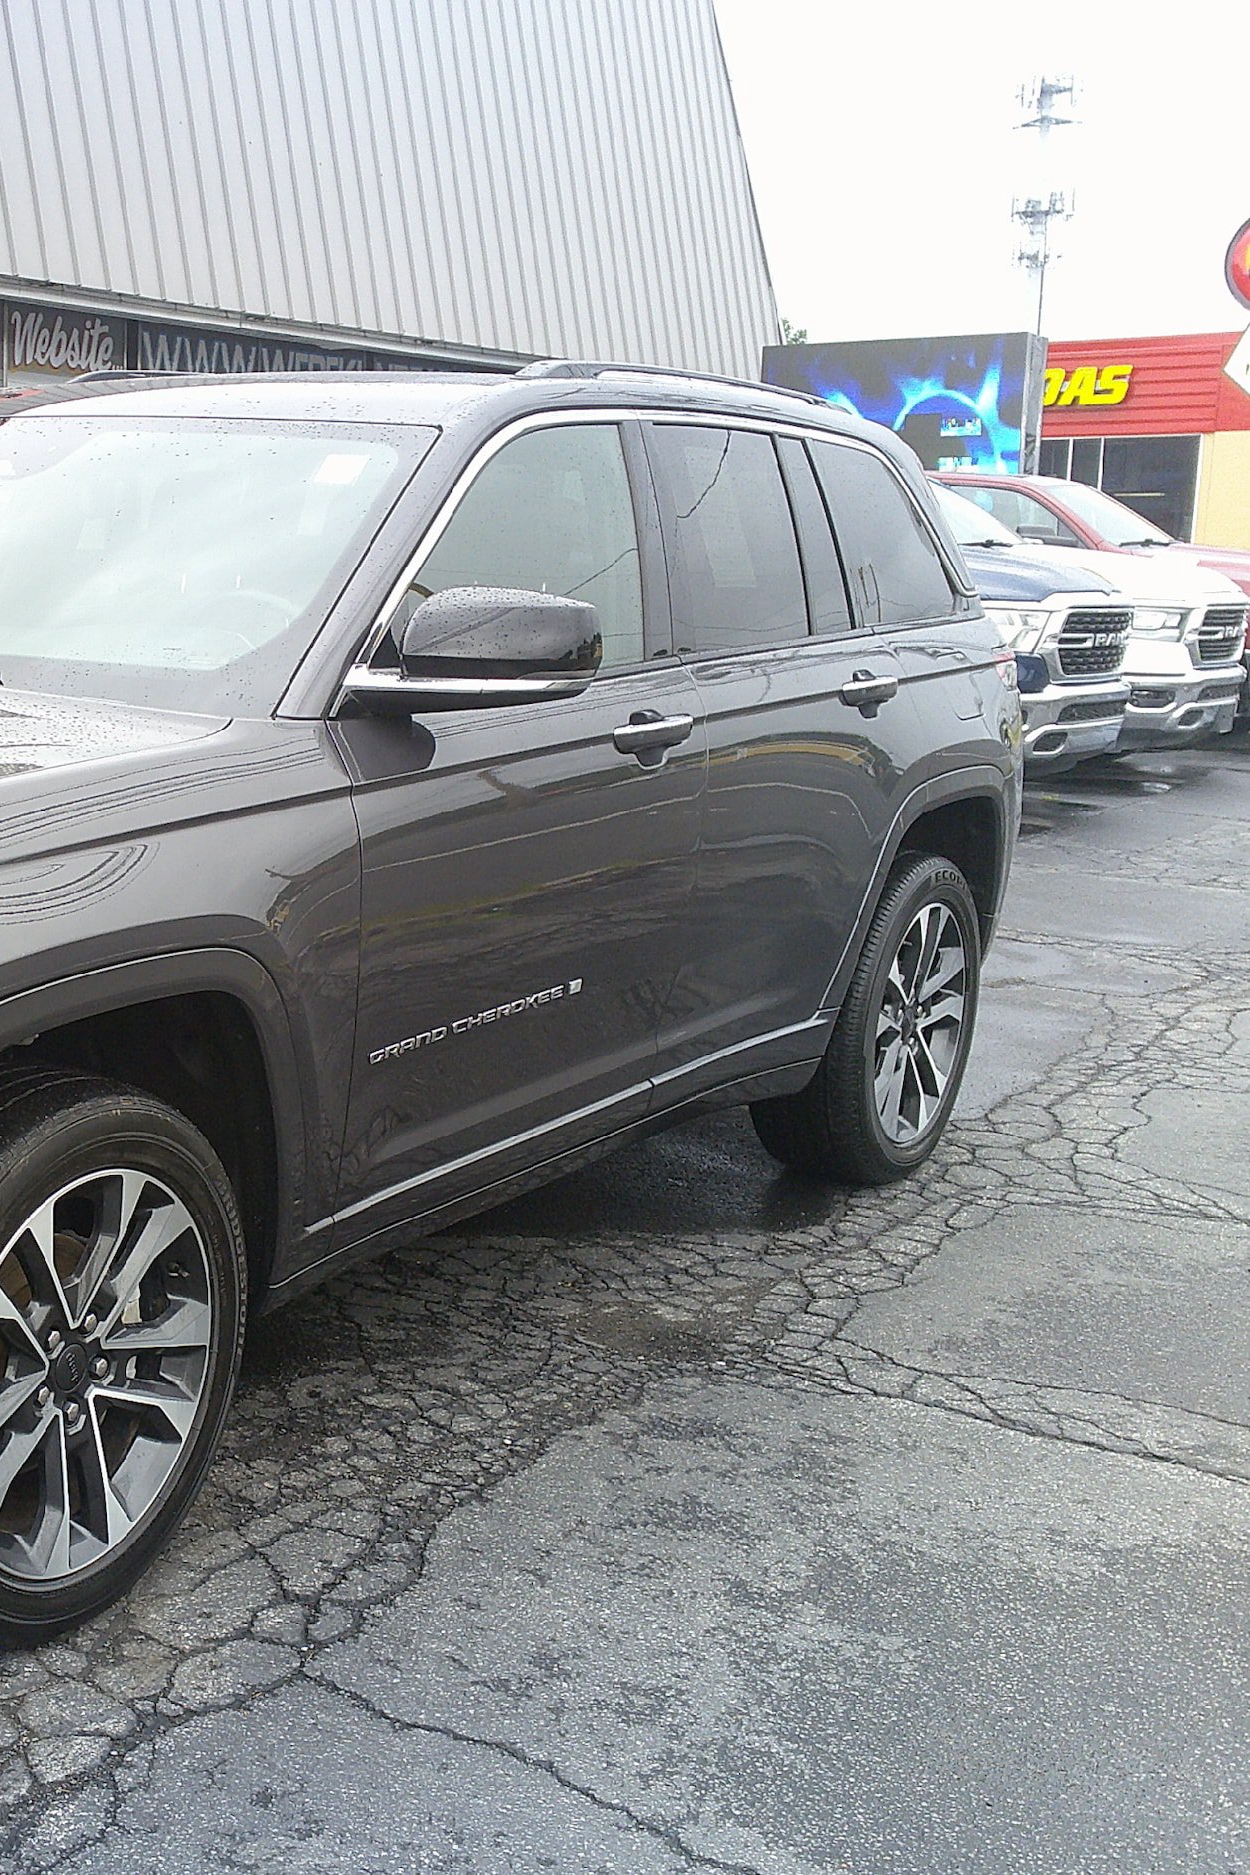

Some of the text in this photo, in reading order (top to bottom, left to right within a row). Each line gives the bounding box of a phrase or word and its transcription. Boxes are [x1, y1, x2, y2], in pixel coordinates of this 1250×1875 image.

[1096, 631, 1126, 647] RAM
[369, 984, 564, 1065] GRAND CHEROKEE
